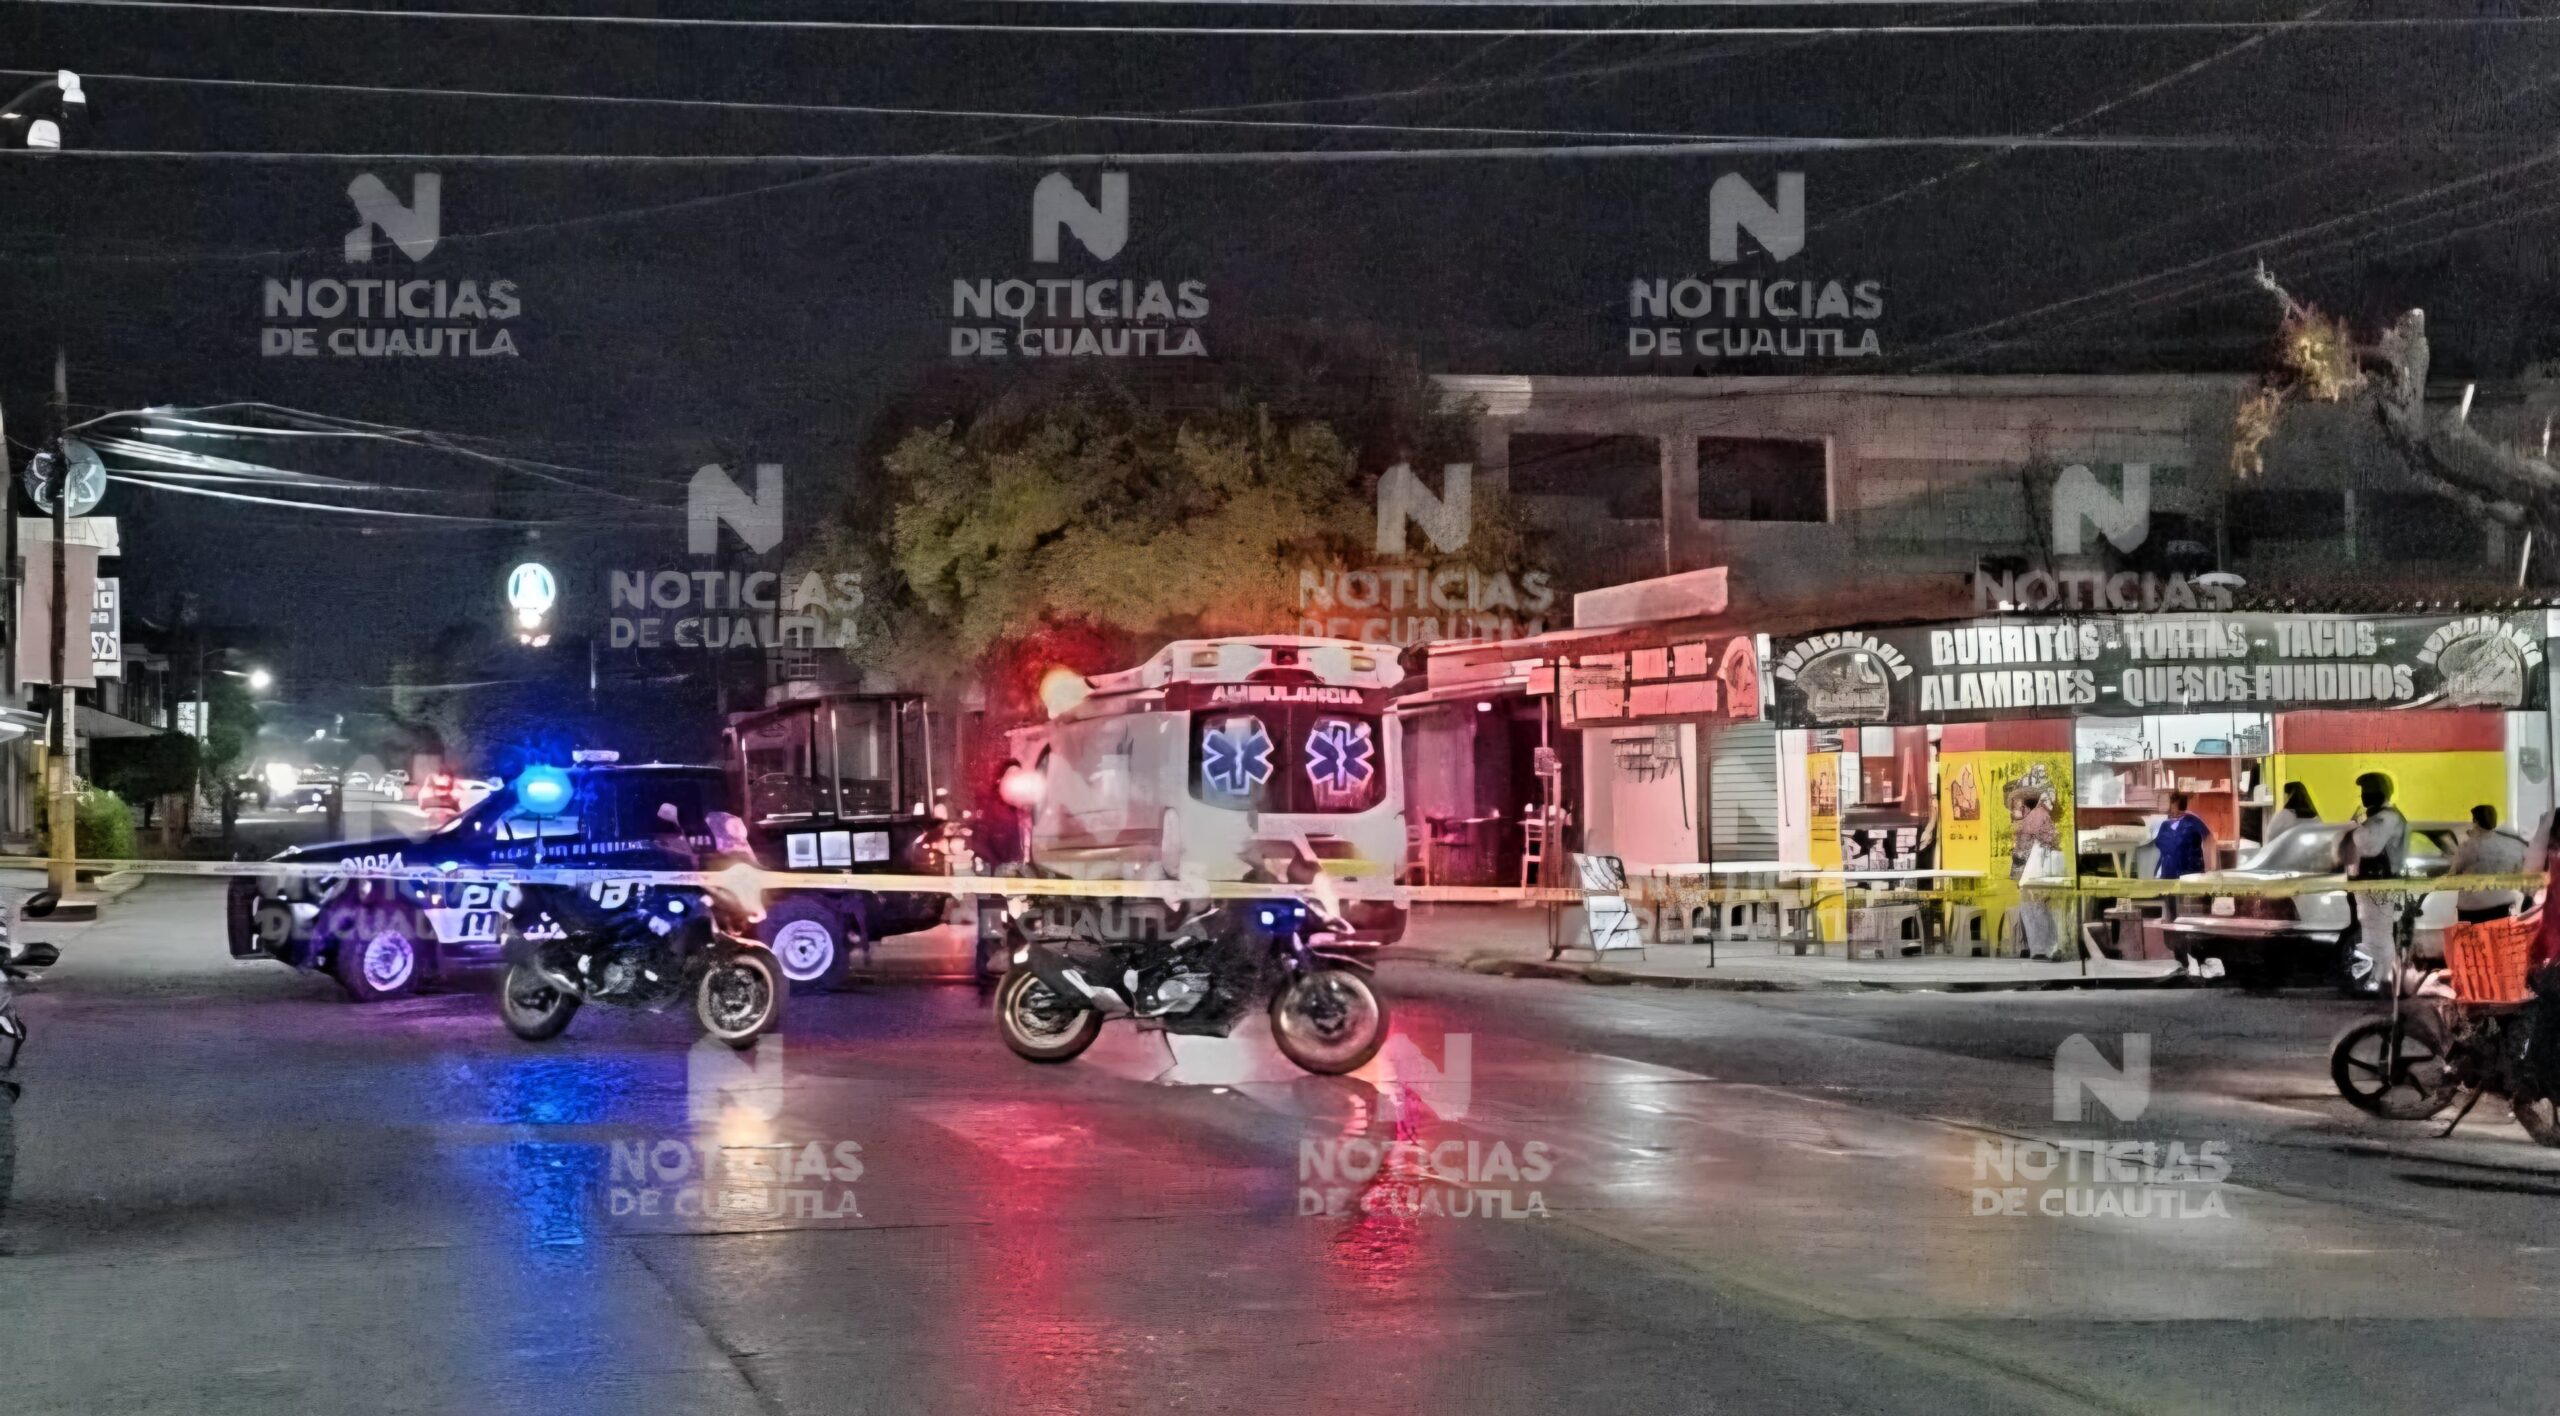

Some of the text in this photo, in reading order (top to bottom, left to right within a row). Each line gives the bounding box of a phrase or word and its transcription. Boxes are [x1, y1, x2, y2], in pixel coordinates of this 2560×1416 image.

[1931, 622, 2100, 666] BURRITOS
[2122, 619, 2249, 660] TORTAS
[2273, 620, 2378, 659] TACOS
[1920, 663, 2415, 712] ALAMBRES QUESOS FUNDIDOS
